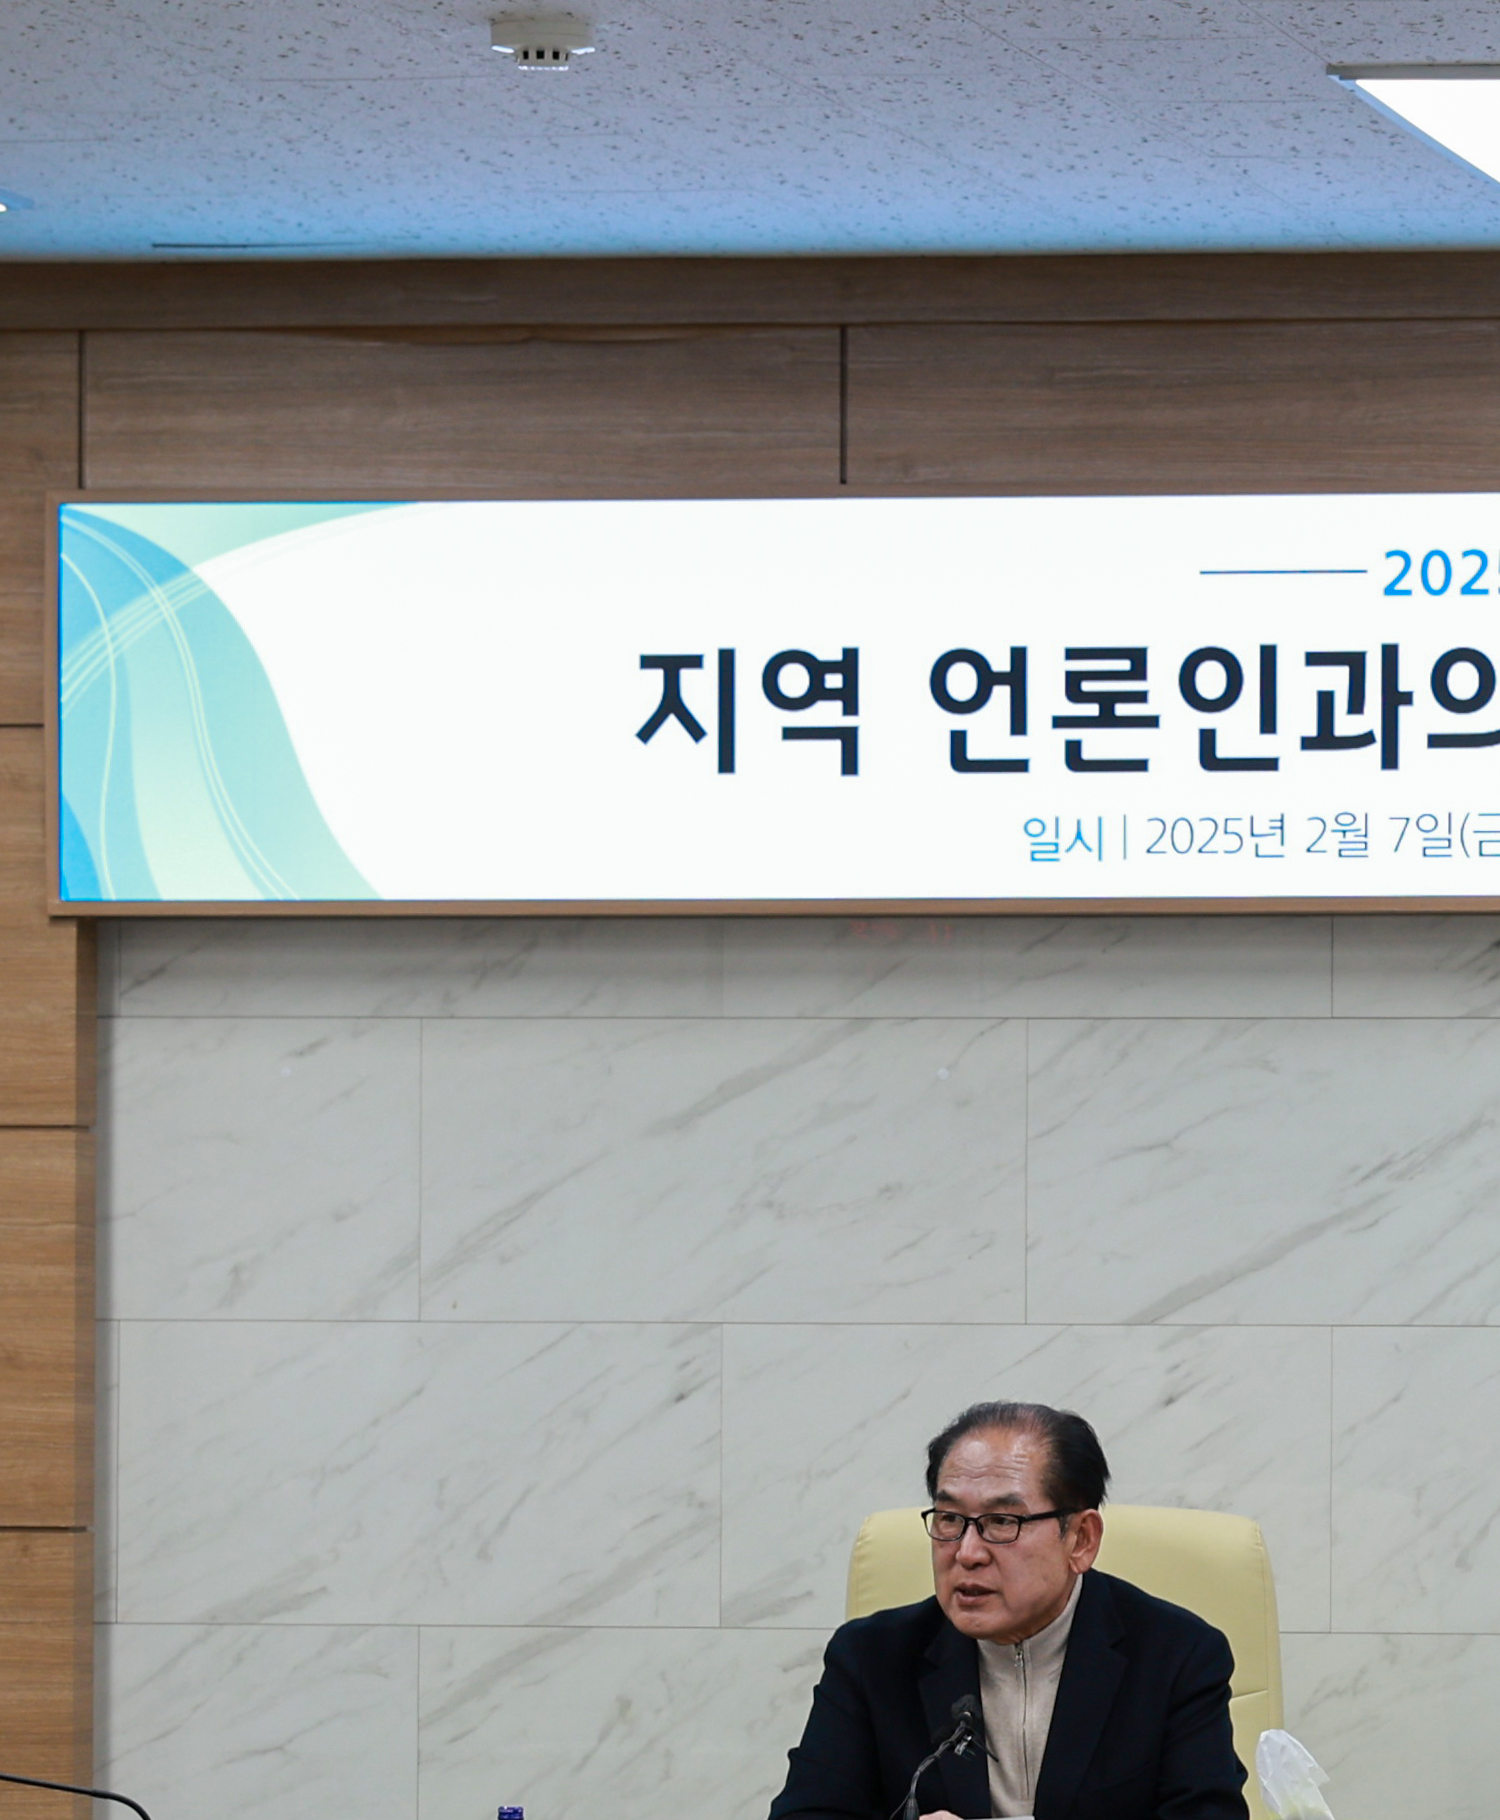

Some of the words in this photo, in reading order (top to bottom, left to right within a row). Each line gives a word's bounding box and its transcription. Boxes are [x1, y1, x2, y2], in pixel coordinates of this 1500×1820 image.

[633, 645, 861, 778] 지역
[1023, 815, 1104, 863] 일시
[1145, 812, 1286, 859] 2025년
[1305, 811, 1369, 859] 2월
